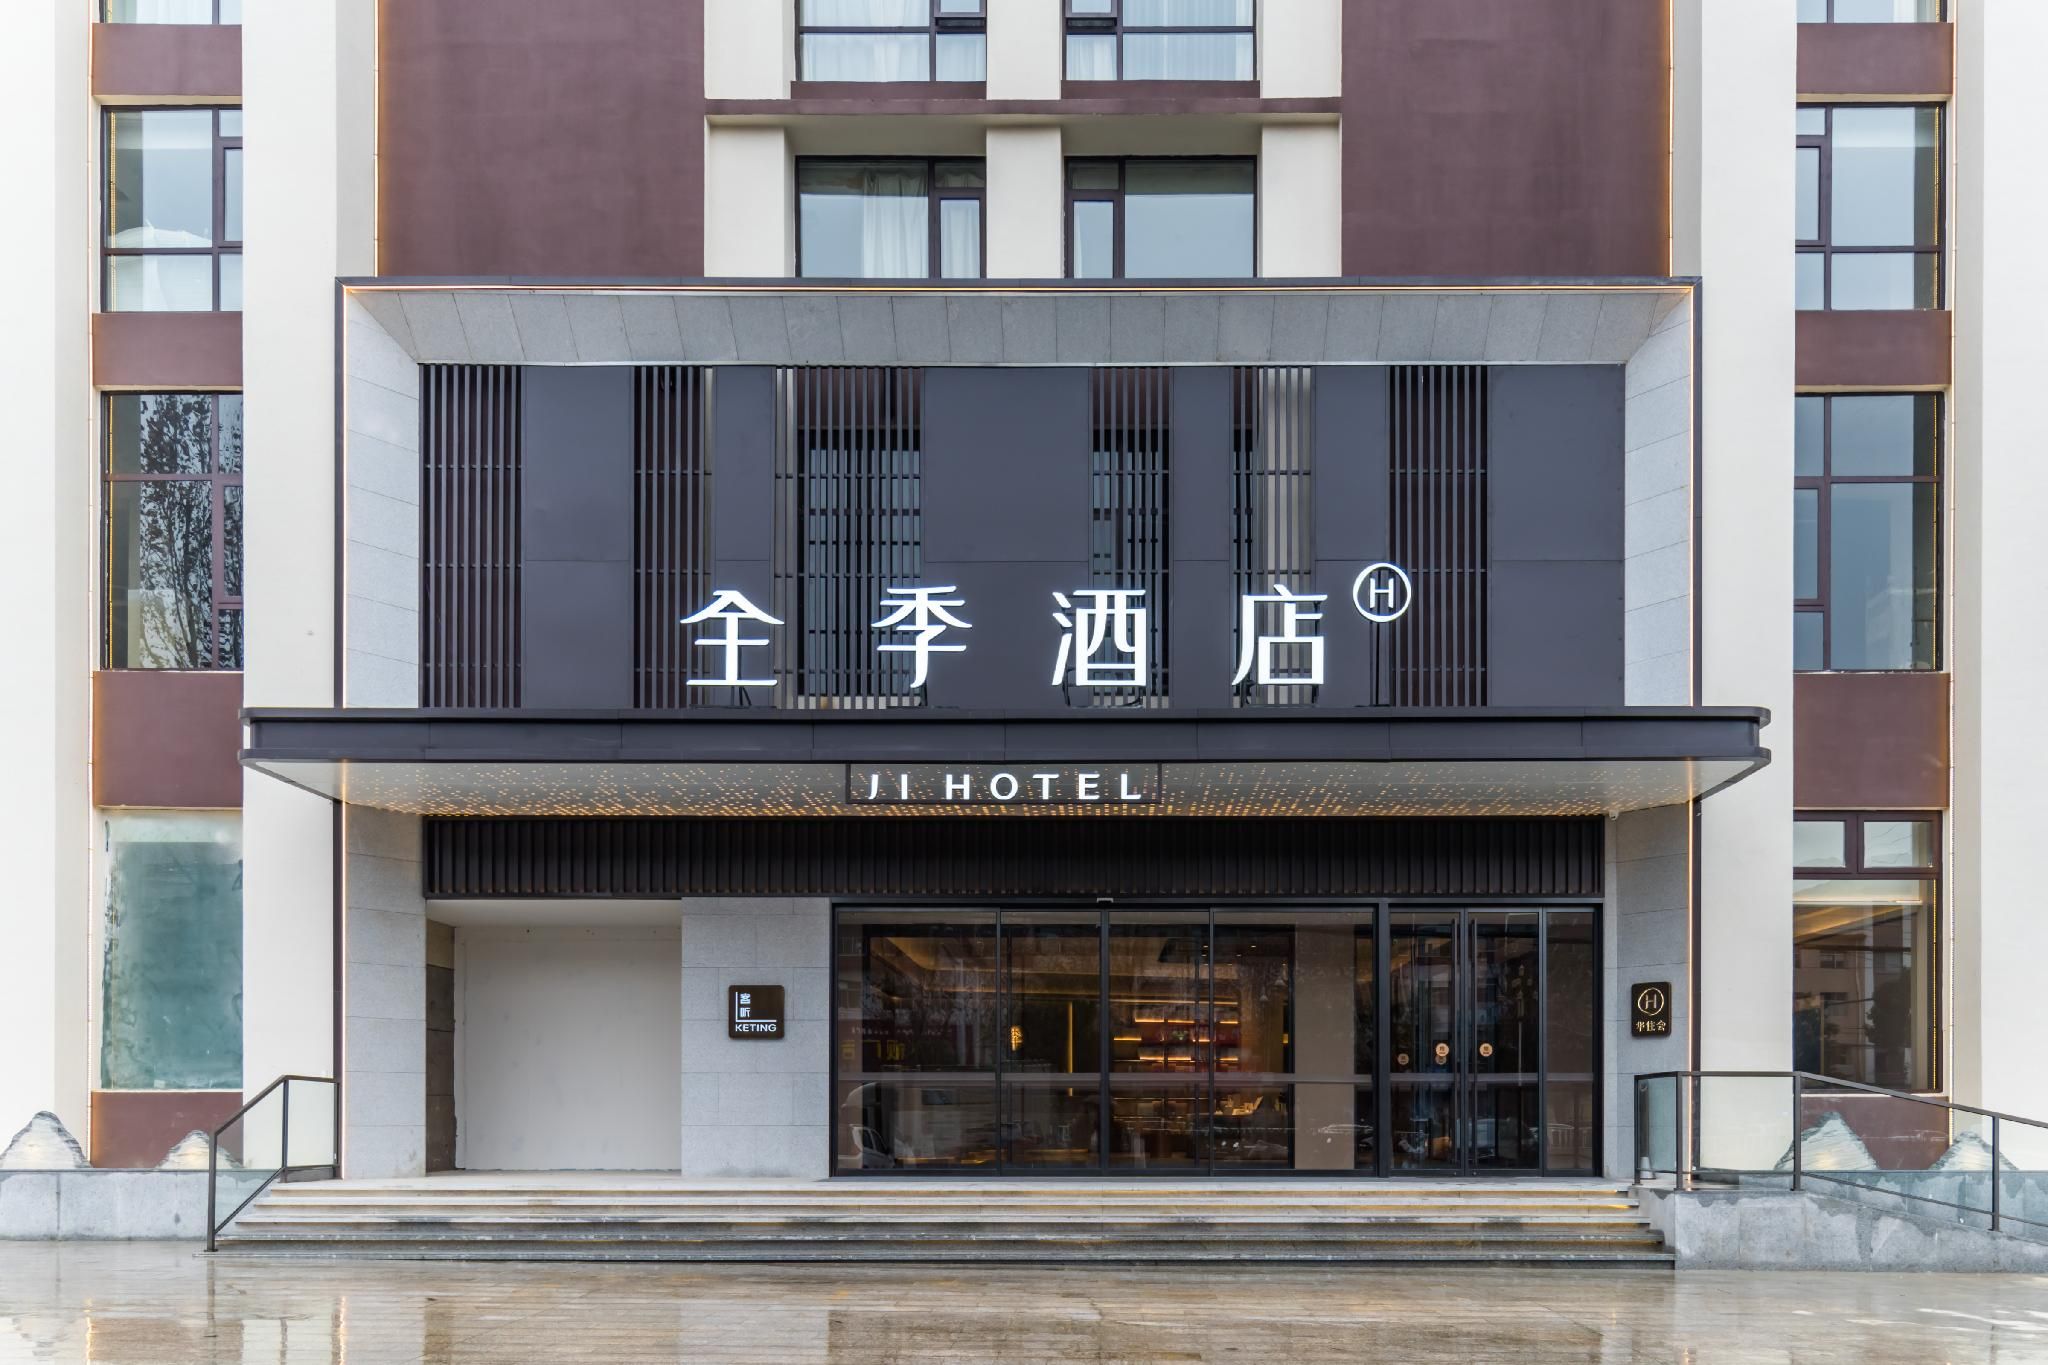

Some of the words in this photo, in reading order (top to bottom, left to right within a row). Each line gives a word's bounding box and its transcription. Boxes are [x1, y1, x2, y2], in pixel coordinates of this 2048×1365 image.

[680, 583, 1328, 689] 全季酒店
[867, 773, 909, 800] JI
[945, 773, 1142, 801] HOTEL
[735, 1023, 777, 1032] KETING
